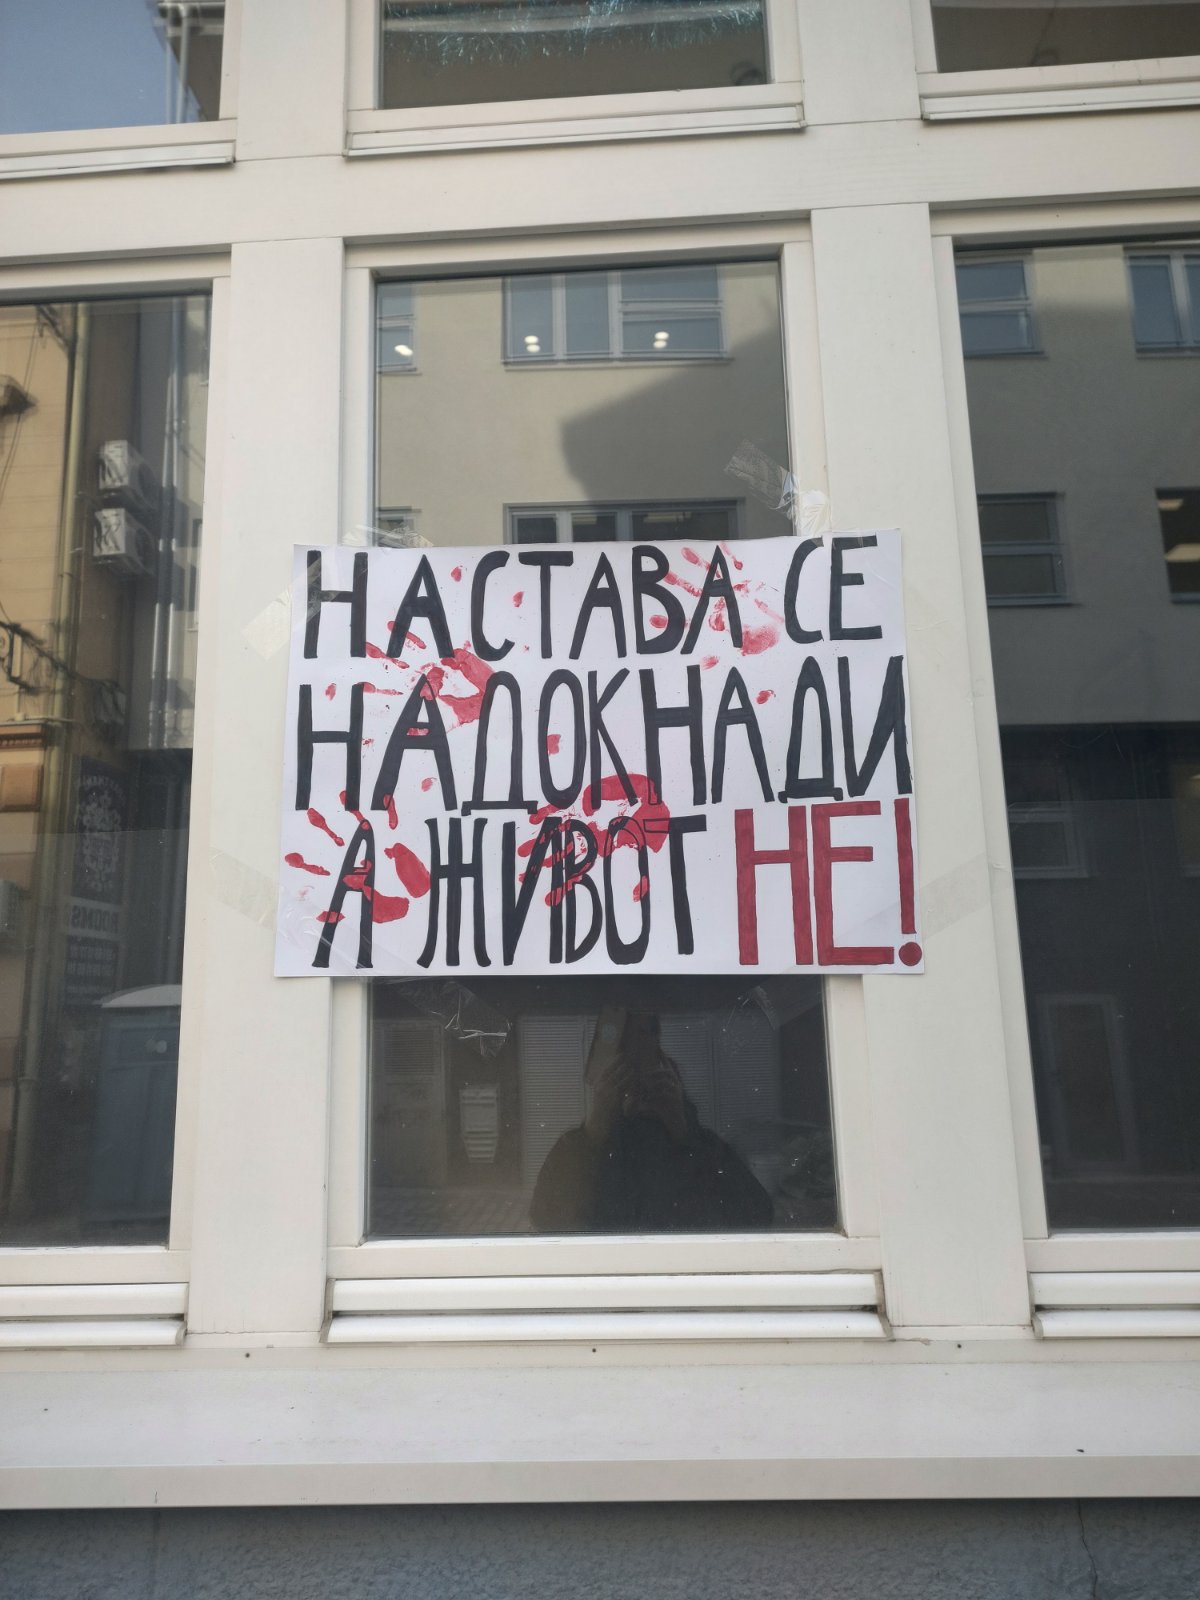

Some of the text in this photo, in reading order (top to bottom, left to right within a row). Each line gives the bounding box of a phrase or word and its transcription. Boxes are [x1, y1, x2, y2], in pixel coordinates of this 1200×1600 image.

[303, 534, 883, 659] НАСТАВА СЕ
[295, 655, 913, 816] НАДОКНАДИ
[311, 798, 924, 969] А ЖИВОТ НЕ!
